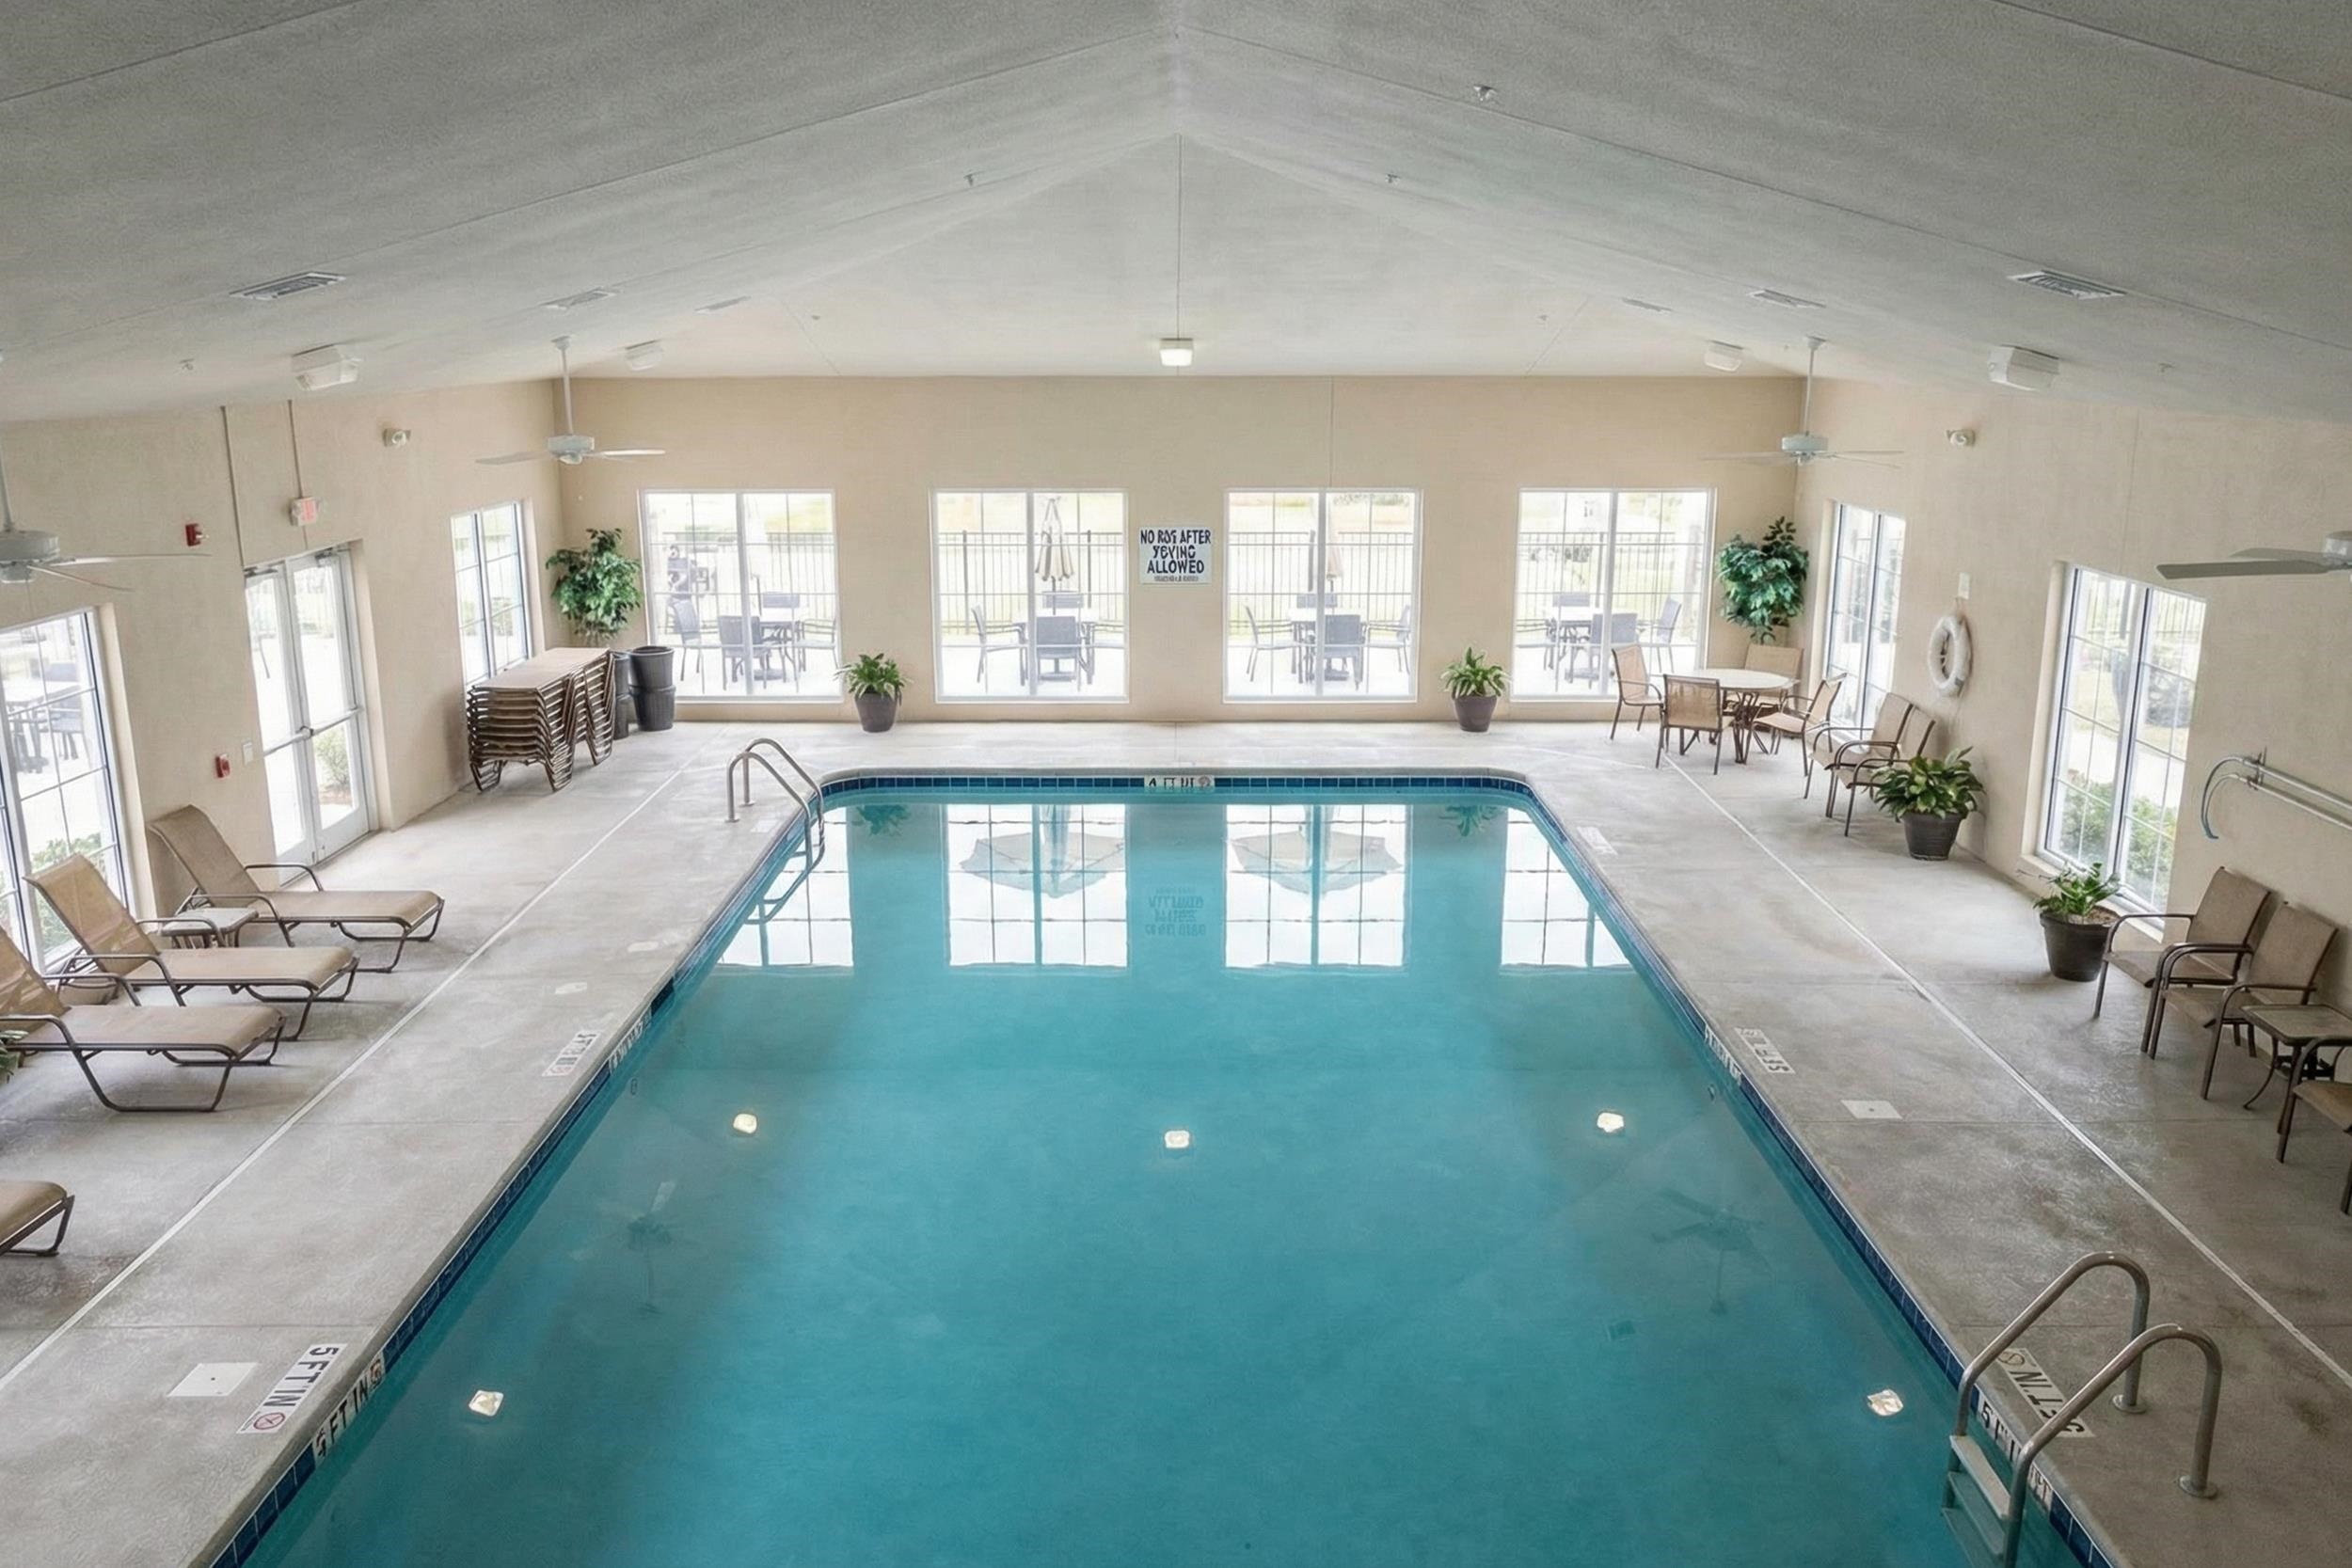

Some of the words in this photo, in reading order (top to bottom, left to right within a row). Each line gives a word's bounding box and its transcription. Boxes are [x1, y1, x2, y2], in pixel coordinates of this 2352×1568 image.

[1140, 529, 1155, 545] NO
[1180, 529, 1212, 545] AFTER
[1147, 560, 1205, 575] ALLOWED
[309, 1346, 340, 1356] 5
[2010, 1370, 2053, 1388] IN
[262, 1389, 307, 1407] IN
[329, 1400, 348, 1444] FT
[353, 1375, 370, 1414] IN
[1980, 1401, 1994, 1429] 5
